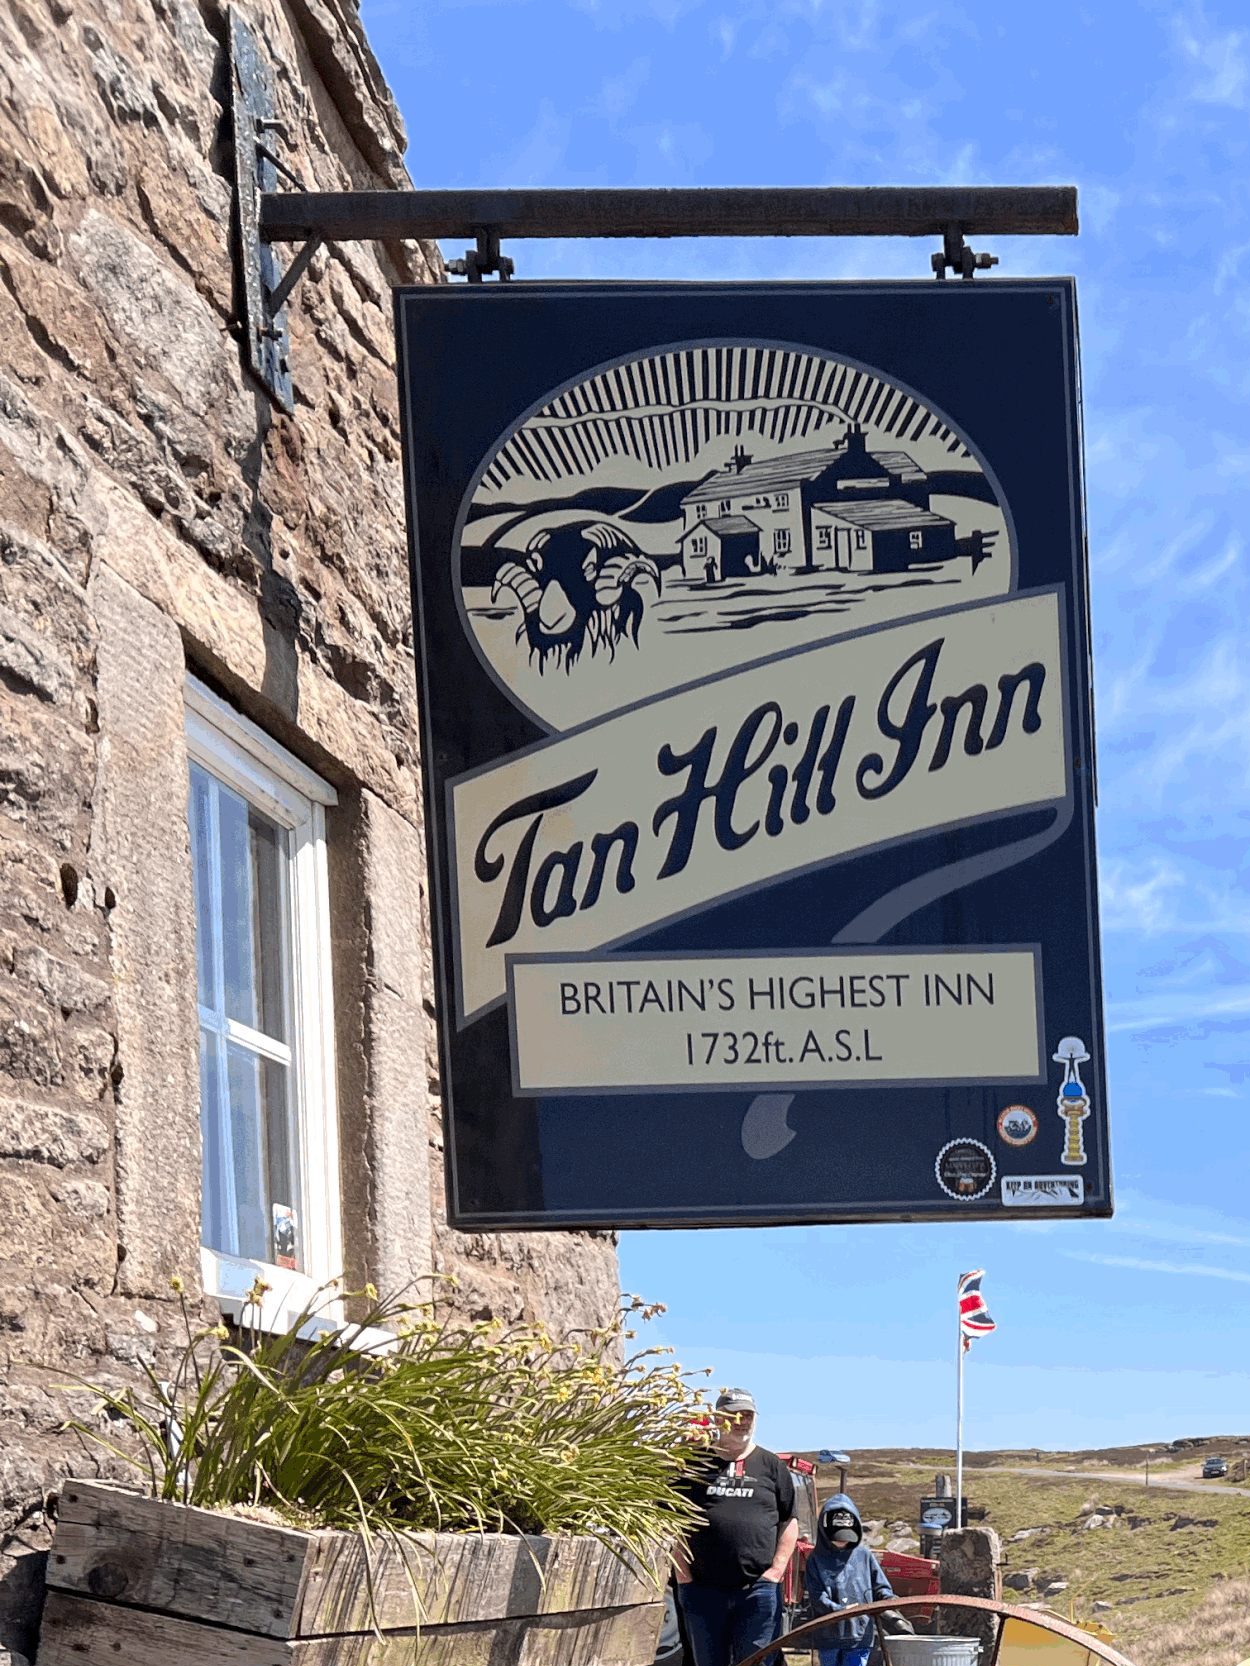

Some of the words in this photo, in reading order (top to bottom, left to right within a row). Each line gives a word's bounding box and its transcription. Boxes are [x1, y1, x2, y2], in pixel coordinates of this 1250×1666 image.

[475, 767, 640, 948] Tan
[652, 695, 856, 880] Hill
[857, 637, 1046, 800] Inn
[560, 978, 736, 1015] BRITAIN'S
[749, 974, 910, 1011] HIGHEST
[924, 972, 995, 1007] INN
[706, 1485, 754, 1498] DUCATI
